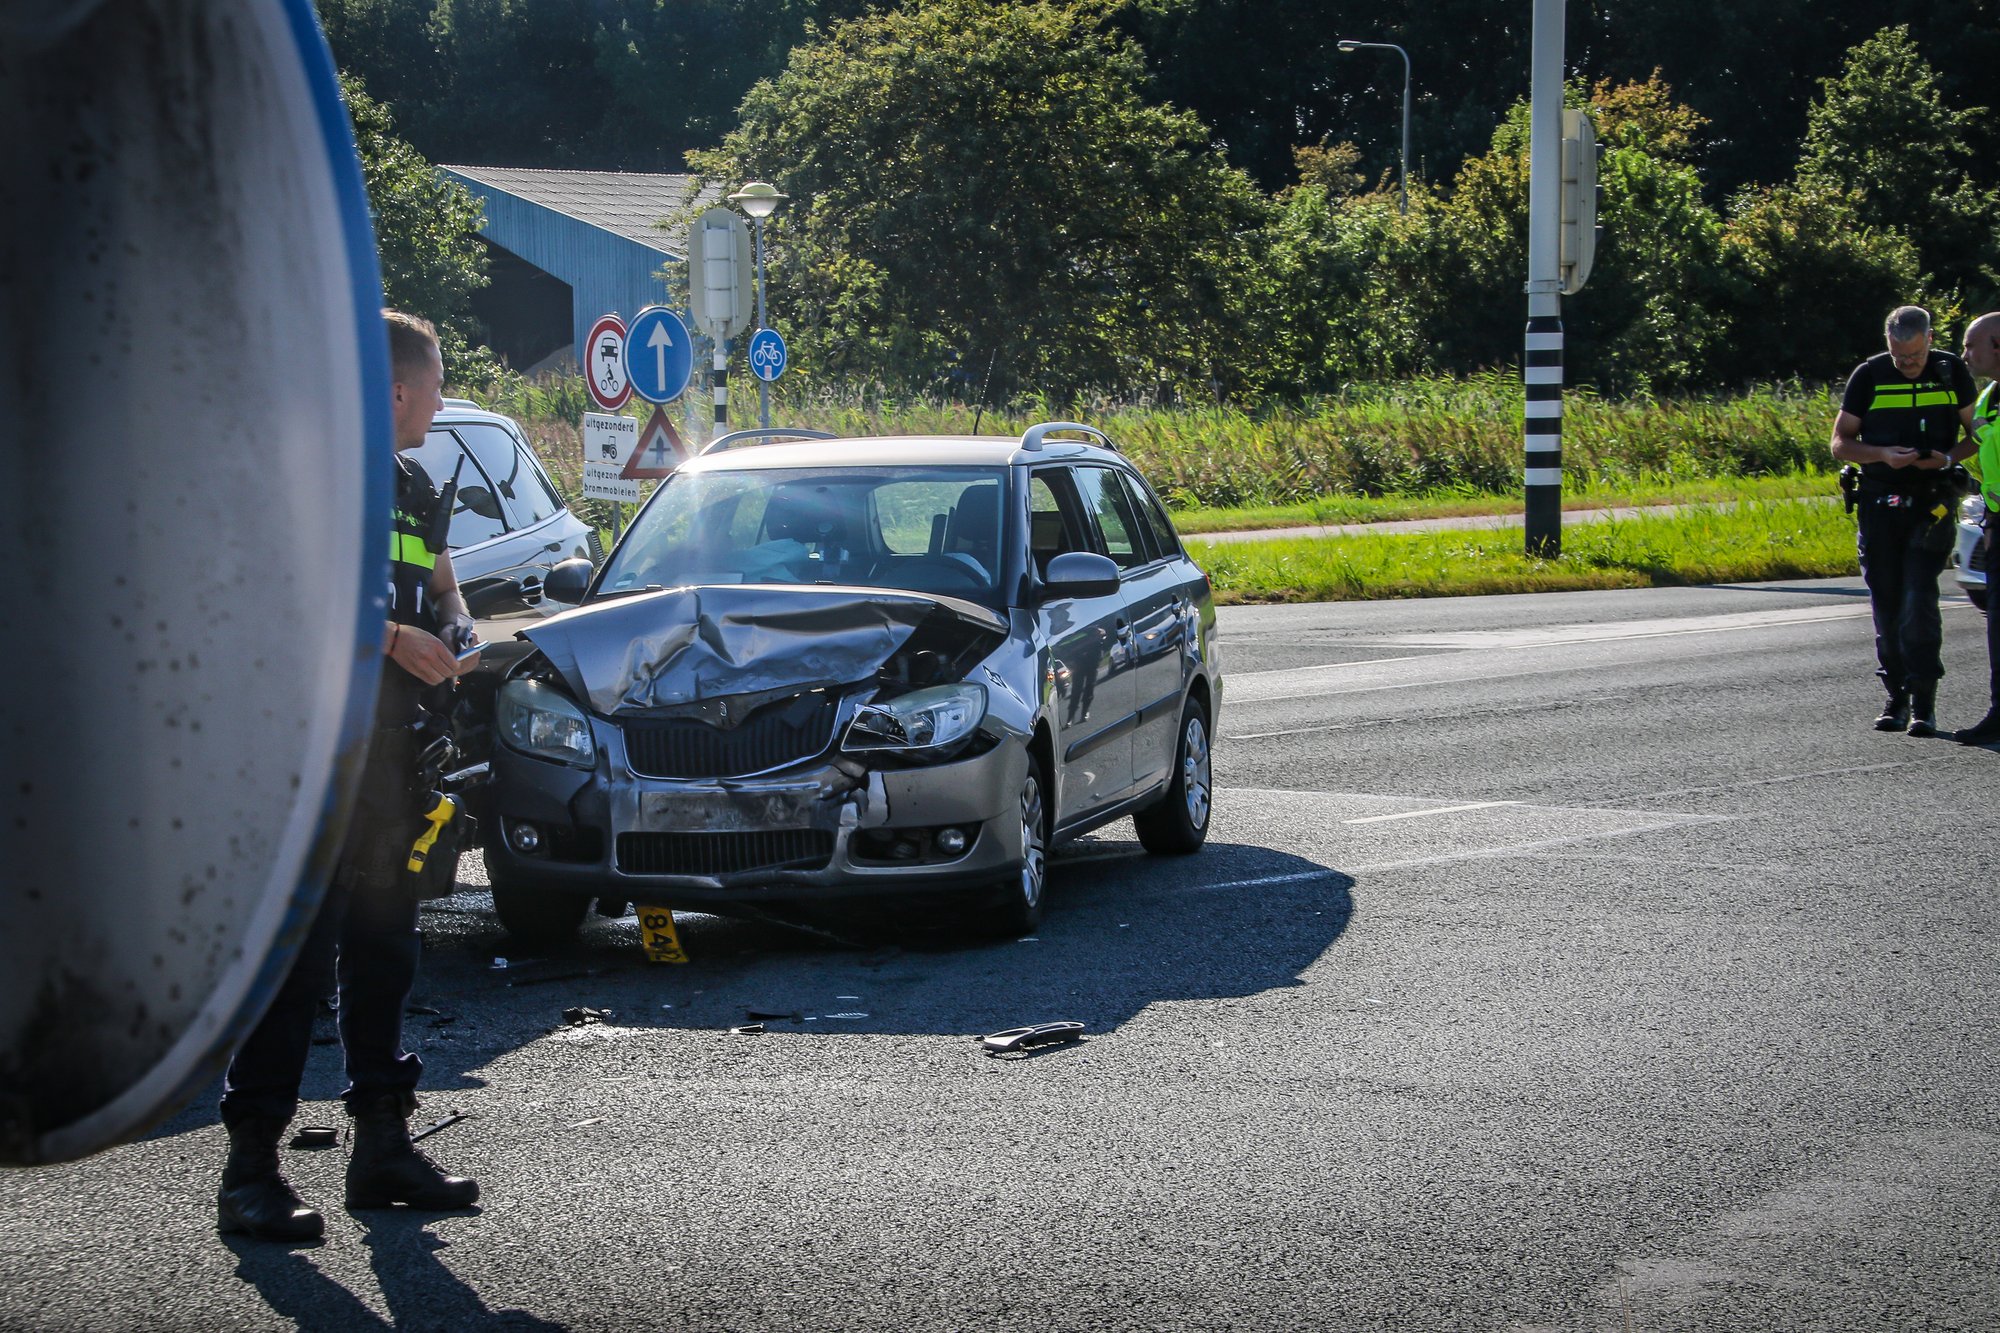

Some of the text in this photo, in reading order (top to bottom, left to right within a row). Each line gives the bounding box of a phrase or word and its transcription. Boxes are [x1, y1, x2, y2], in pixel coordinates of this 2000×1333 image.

[586, 418, 634, 432] uitgezonderd
[586, 468, 634, 482] uitgezon
[584, 483, 636, 497] brommobielen
